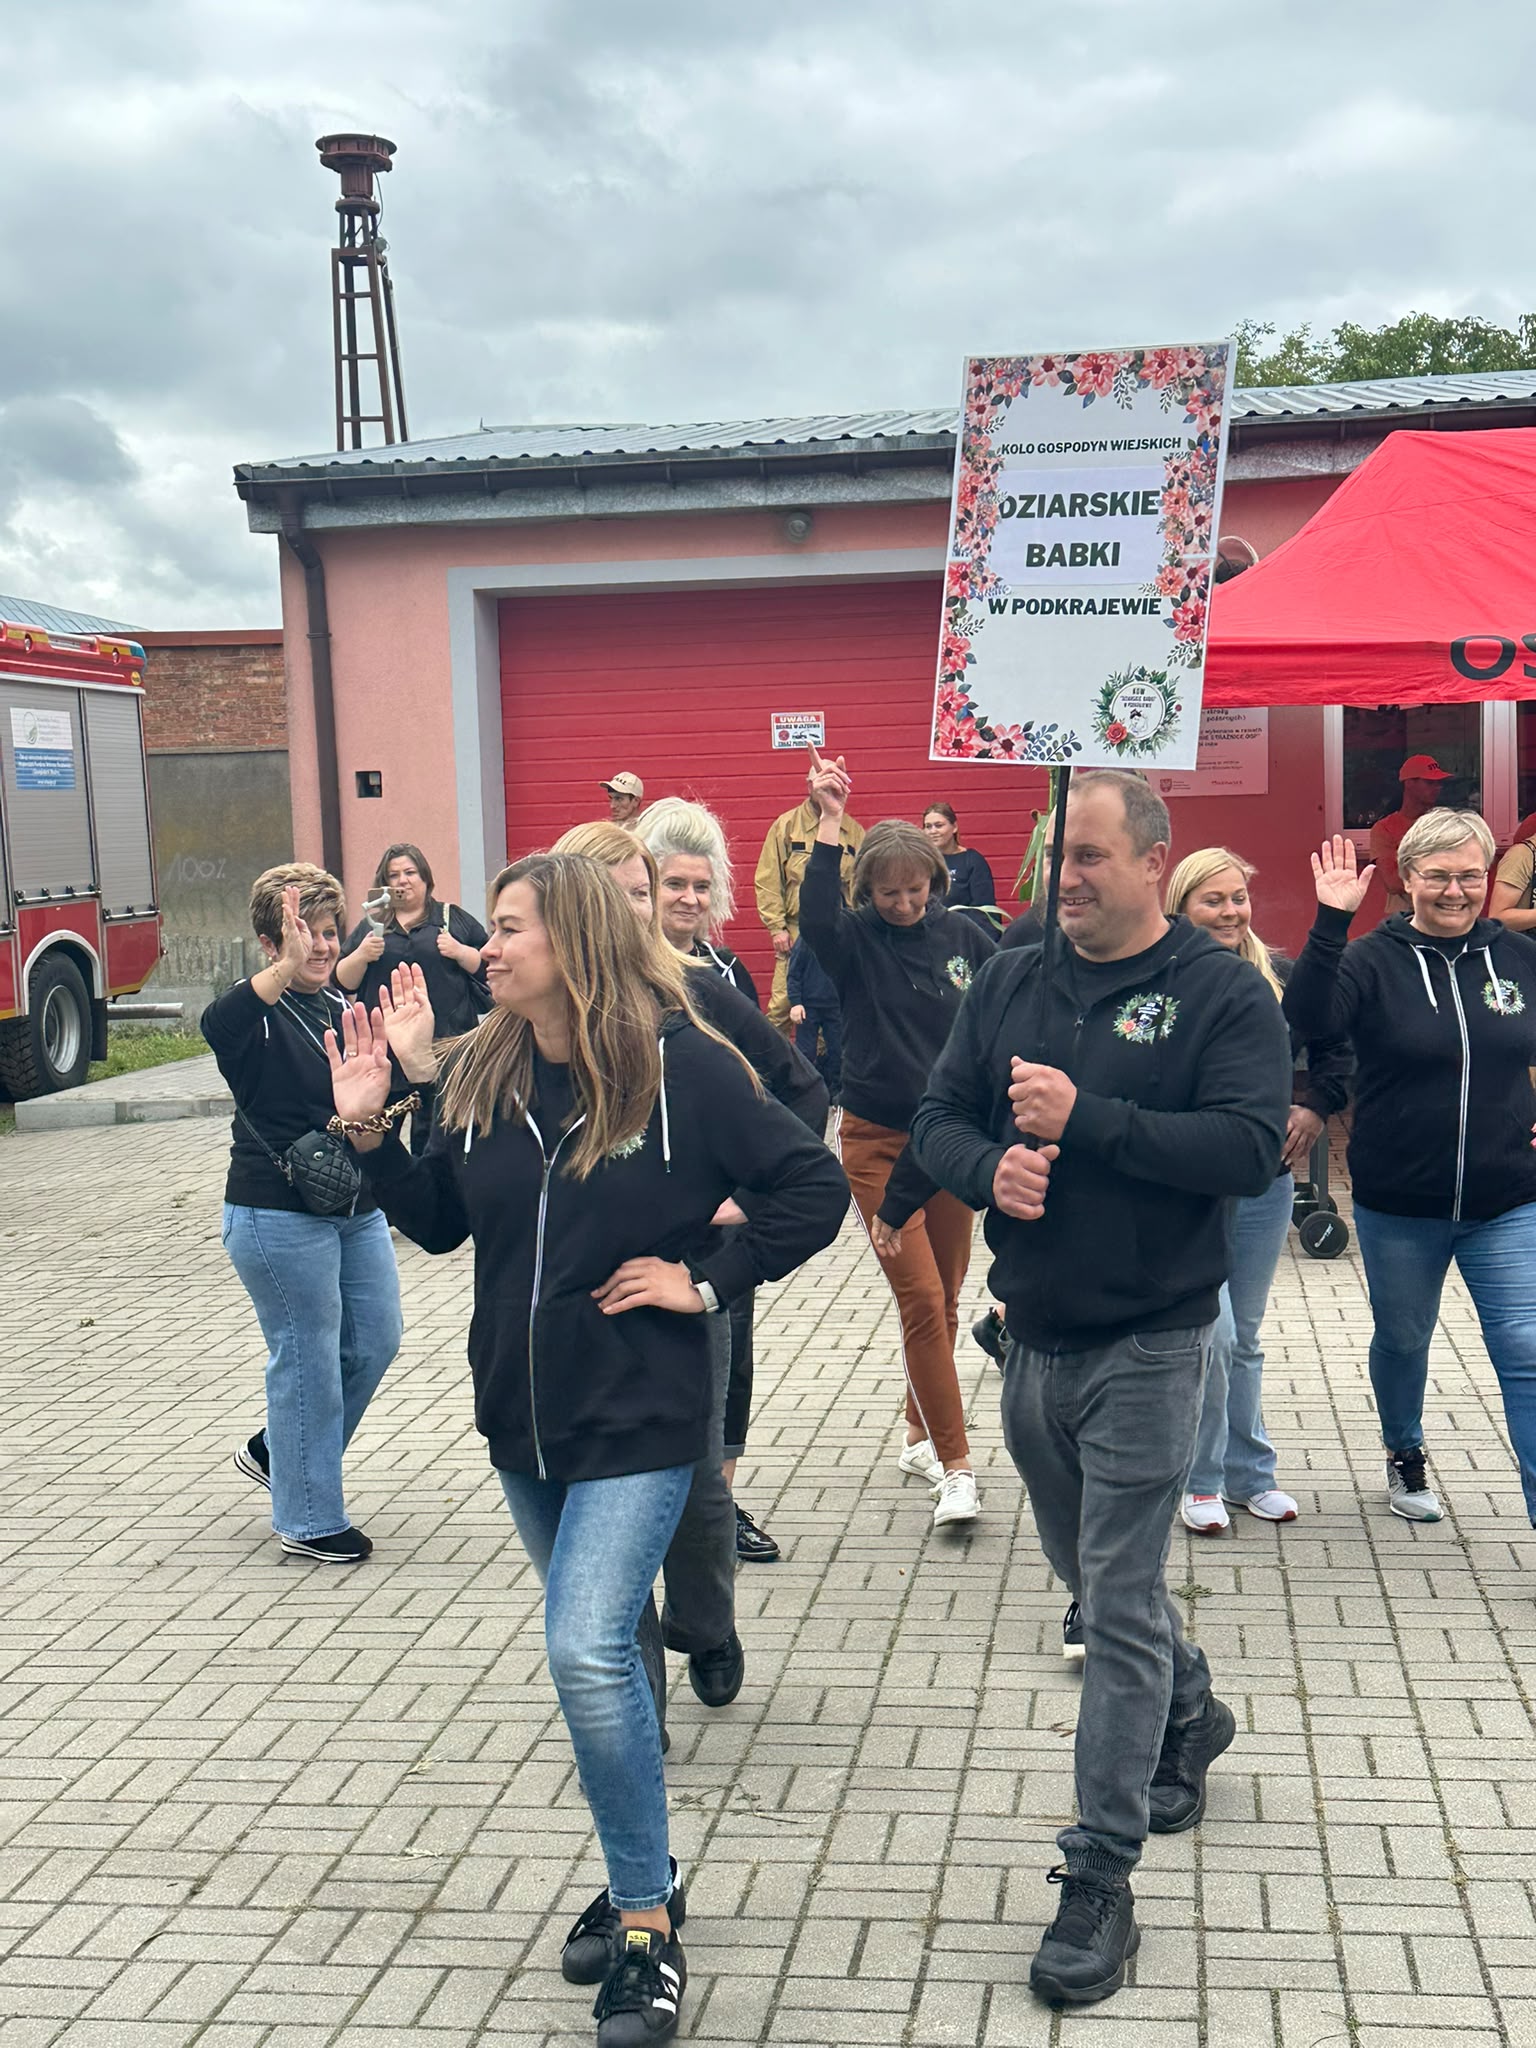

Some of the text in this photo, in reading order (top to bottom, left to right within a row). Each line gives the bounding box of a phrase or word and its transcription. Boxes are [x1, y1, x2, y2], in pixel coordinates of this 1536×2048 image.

[1001, 437, 1181, 455] KOLO GOSPODYN WIEJSKICH
[1026, 542, 1120, 567] BABKI
[989, 598, 1162, 615] W PODKRAJEWIE
[780, 715, 816, 723] UWAGA
